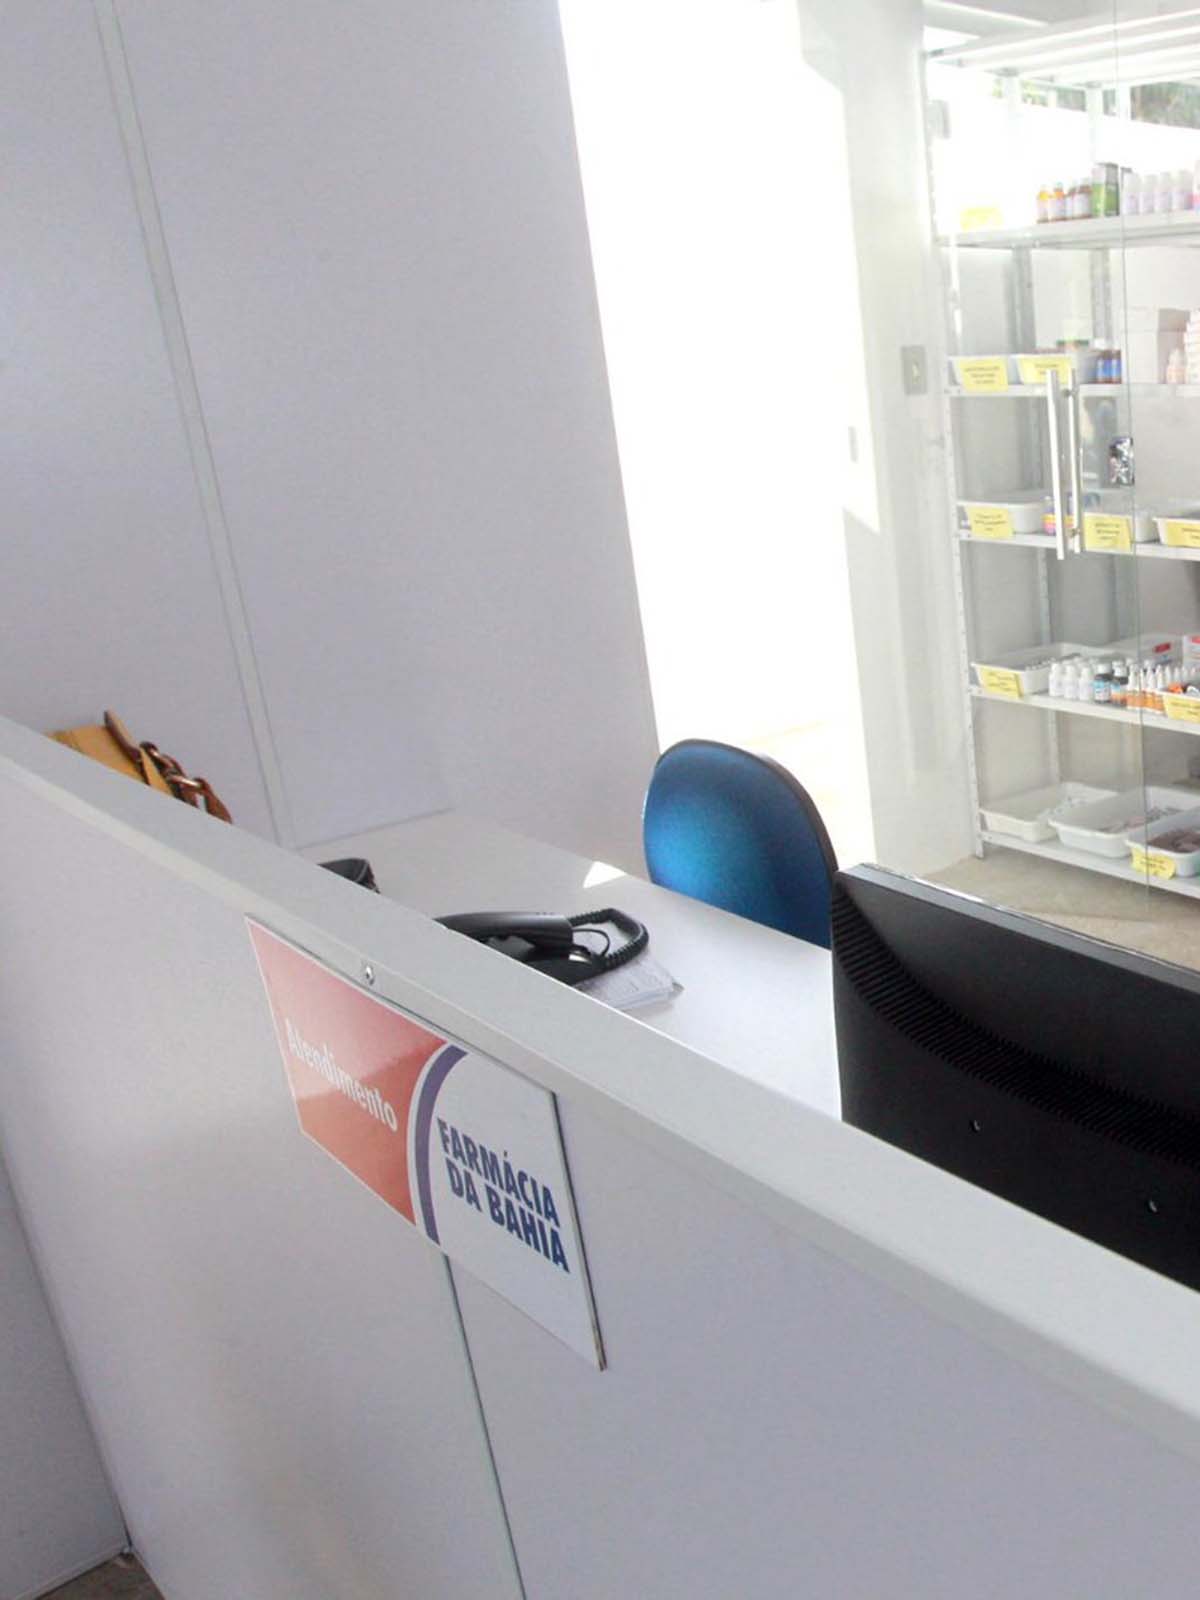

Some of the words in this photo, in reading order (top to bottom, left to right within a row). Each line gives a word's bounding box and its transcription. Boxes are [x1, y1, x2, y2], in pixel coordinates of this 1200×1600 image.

[285, 1018, 398, 1132] Atendimento
[437, 1116, 561, 1228] FARMÁCIA
[445, 1156, 482, 1213] DA
[485, 1183, 571, 1275] BAHIA
